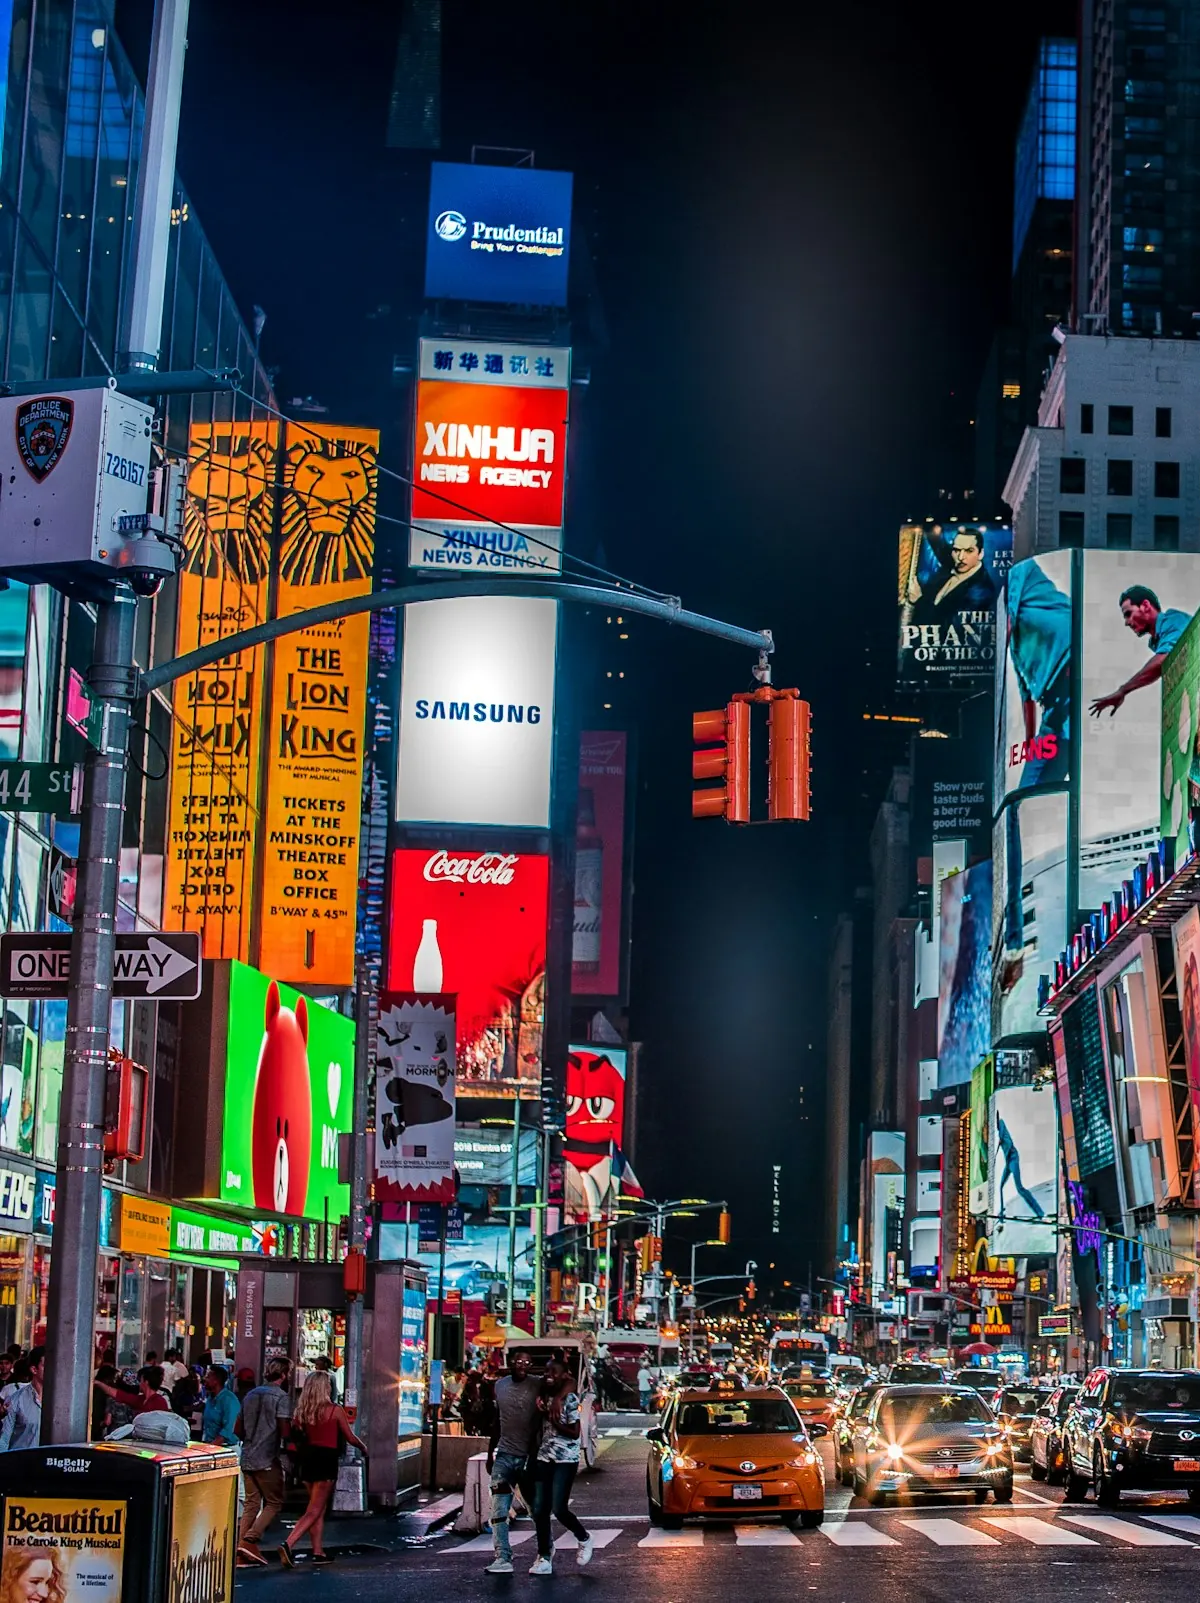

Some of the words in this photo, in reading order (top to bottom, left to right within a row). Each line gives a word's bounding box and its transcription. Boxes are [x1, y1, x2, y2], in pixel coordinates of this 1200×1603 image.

[472, 222, 564, 244] Prudential
[496, 243, 514, 252] Your
[433, 350, 554, 377] 新华通讯社
[30, 400, 60, 412] POLICE
[19, 410, 70, 427] DEPARTMENT
[44, 450, 60, 471] NEW
[56, 426, 68, 452] YORK
[423, 422, 554, 463] XINHUA
[18, 436, 30, 456] CITY
[26, 456, 34, 469] OF
[421, 463, 470, 483] NEWS
[480, 466, 552, 488] AGENCY
[119, 514, 149, 530] NYPD
[443, 530, 528, 552] XINHUA
[423, 548, 472, 565] NEWS
[476, 552, 548, 569] AGENCY
[958, 610, 994, 624] THE
[296, 646, 341, 669] THE
[914, 647, 938, 662] OF
[942, 648, 978, 660] THE
[288, 673, 349, 710] LION
[416, 700, 541, 724] SAMSUNG
[280, 714, 356, 758] KING
[1009, 733, 1058, 768] JEANS
[294, 765, 357, 776] AWARD-WINNING
[309, 774, 340, 782] MUSICAL
[48, 770, 72, 794] St
[934, 782, 958, 792] Show
[962, 781, 984, 794] your
[283, 796, 346, 812] TICKETS
[933, 794, 958, 805] taste
[960, 792, 984, 805] buds
[933, 807, 940, 816] a
[944, 805, 971, 817] berry
[286, 815, 306, 827] AT
[312, 816, 340, 829] THE
[933, 818, 956, 830] good
[959, 816, 982, 828] time
[270, 834, 356, 848] MINSKOFF
[278, 850, 346, 865] THEATRE
[294, 869, 328, 882] BOX
[284, 886, 338, 900] OFFICE
[270, 906, 308, 917] B'WAY
[312, 908, 320, 918] &
[324, 909, 348, 919] 45TH
[18, 953, 70, 978] ONE
[114, 953, 172, 978] WAY
[406, 1068, 455, 1076] MORMON
[502, 1144, 514, 1152] GT
[970, 1276, 1016, 1284] McDonald's
[244, 1280, 256, 1338] Newsstand
[46, 1458, 92, 1468] BigBelly
[8, 1505, 124, 1535] Beautiful
[7, 1535, 26, 1546] The
[27, 1536, 58, 1548] Carole
[60, 1536, 83, 1550] King
[84, 1538, 121, 1549] Musical
